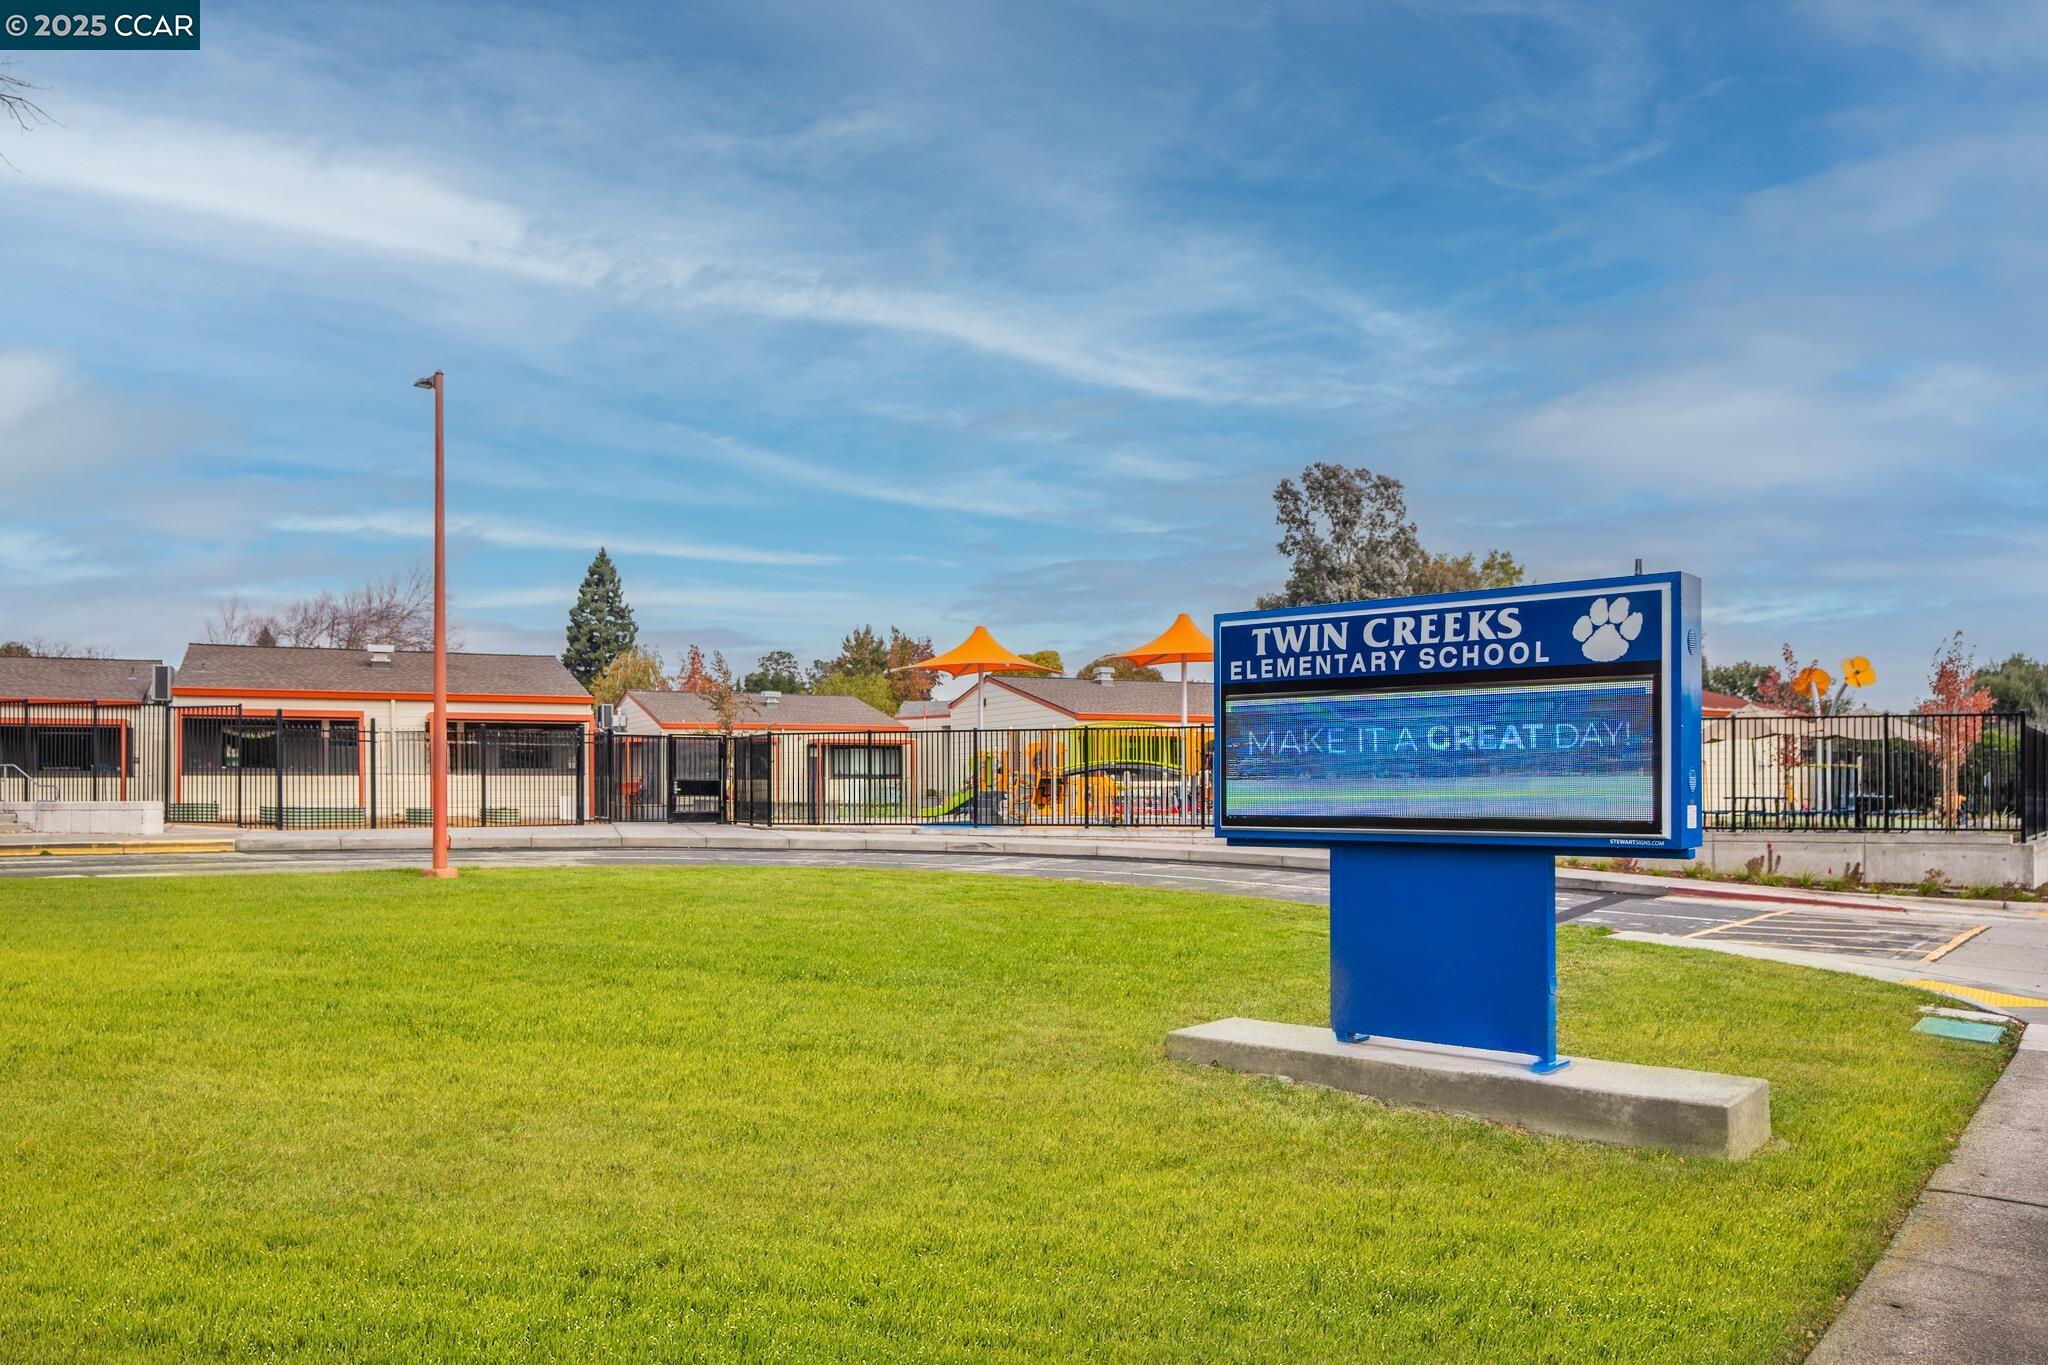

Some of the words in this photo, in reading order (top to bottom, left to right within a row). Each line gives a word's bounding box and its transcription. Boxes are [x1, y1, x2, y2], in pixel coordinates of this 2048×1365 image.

[1251, 622, 1349, 656] TWIN
[1362, 607, 1522, 648] CREEKS
[1230, 650, 1406, 681] ELEMENTARY
[1418, 640, 1550, 669] SCHOOL
[1249, 727, 1346, 755] MAKE
[1358, 727, 1385, 753] IT
[1394, 727, 1418, 752] A
[1427, 723, 1544, 751] GREAT
[1555, 720, 1630, 749] DAY!
